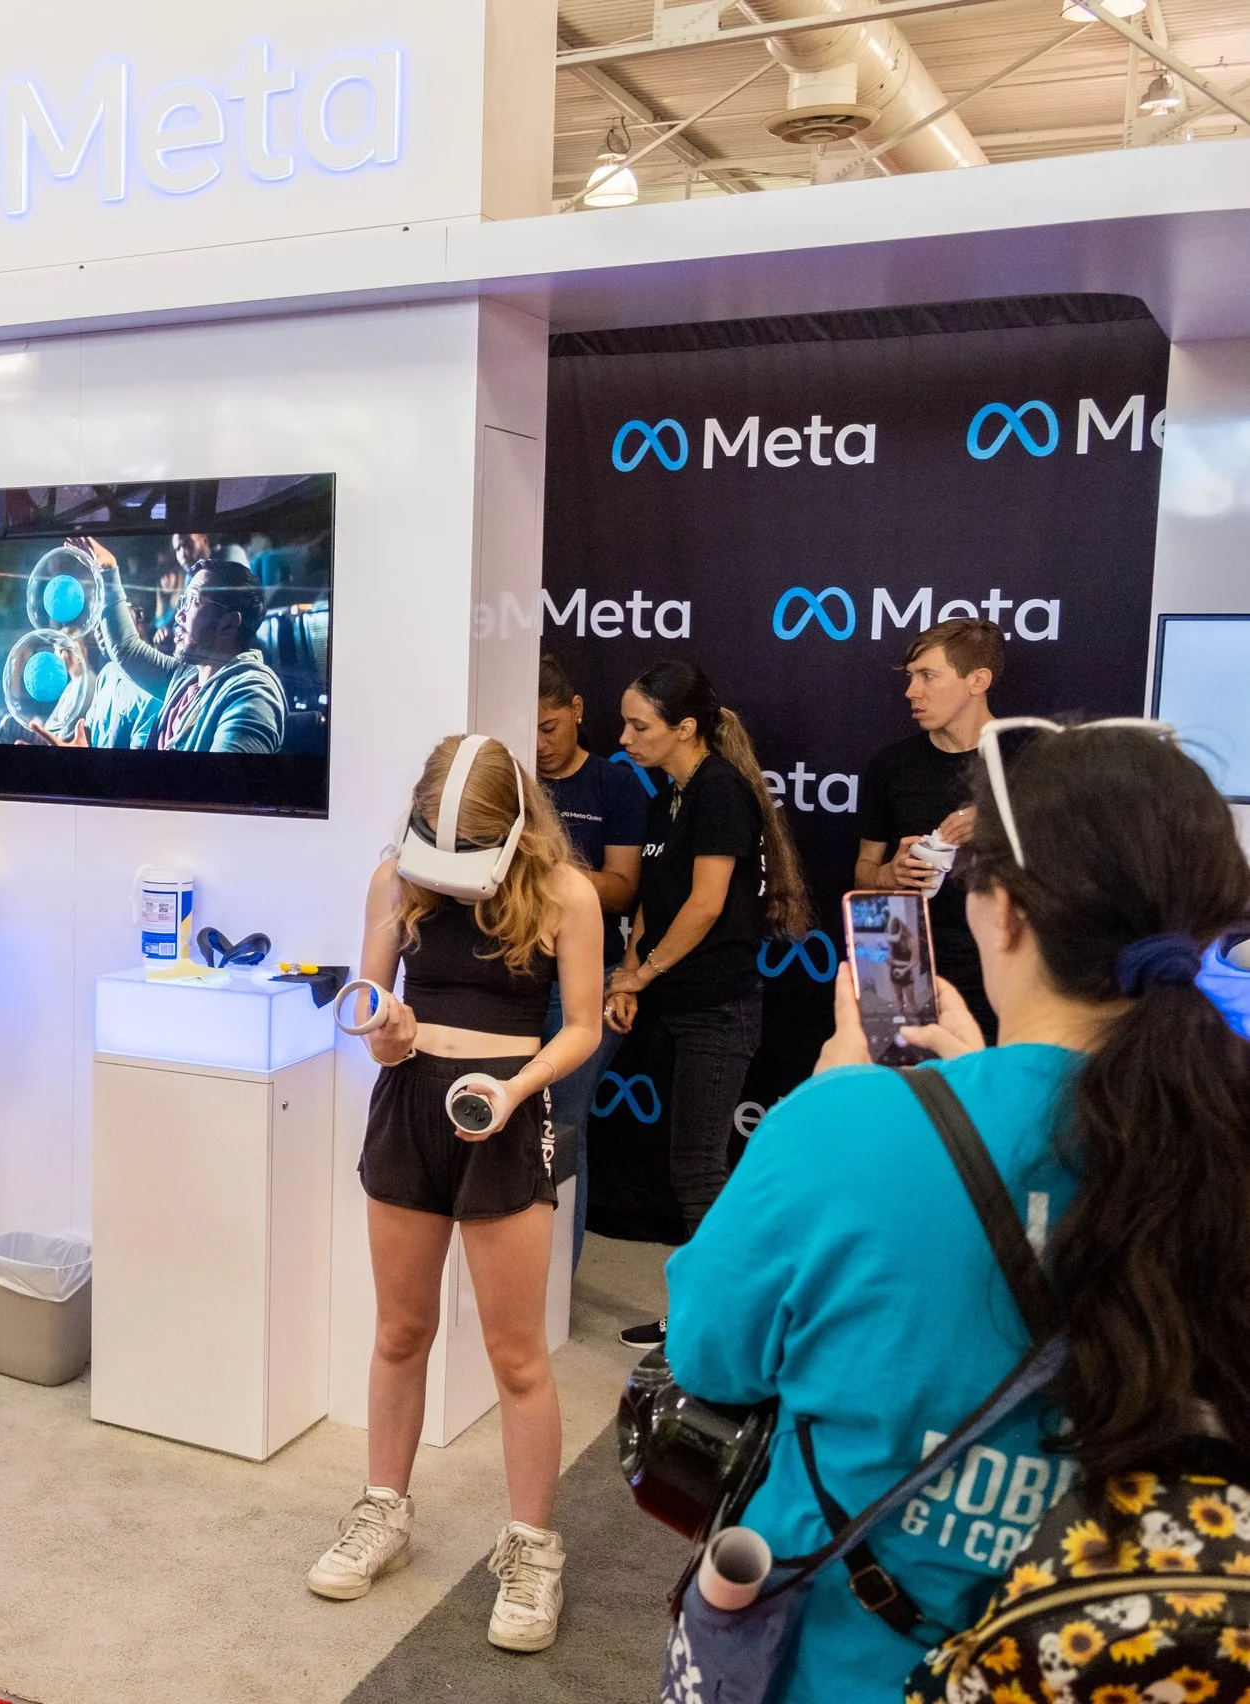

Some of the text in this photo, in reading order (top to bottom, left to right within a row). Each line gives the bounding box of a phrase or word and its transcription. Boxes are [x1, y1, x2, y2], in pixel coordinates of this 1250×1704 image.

[4, 40, 405, 217] Meta
[703, 415, 876, 469] Meta
[539, 588, 692, 639] Meta
